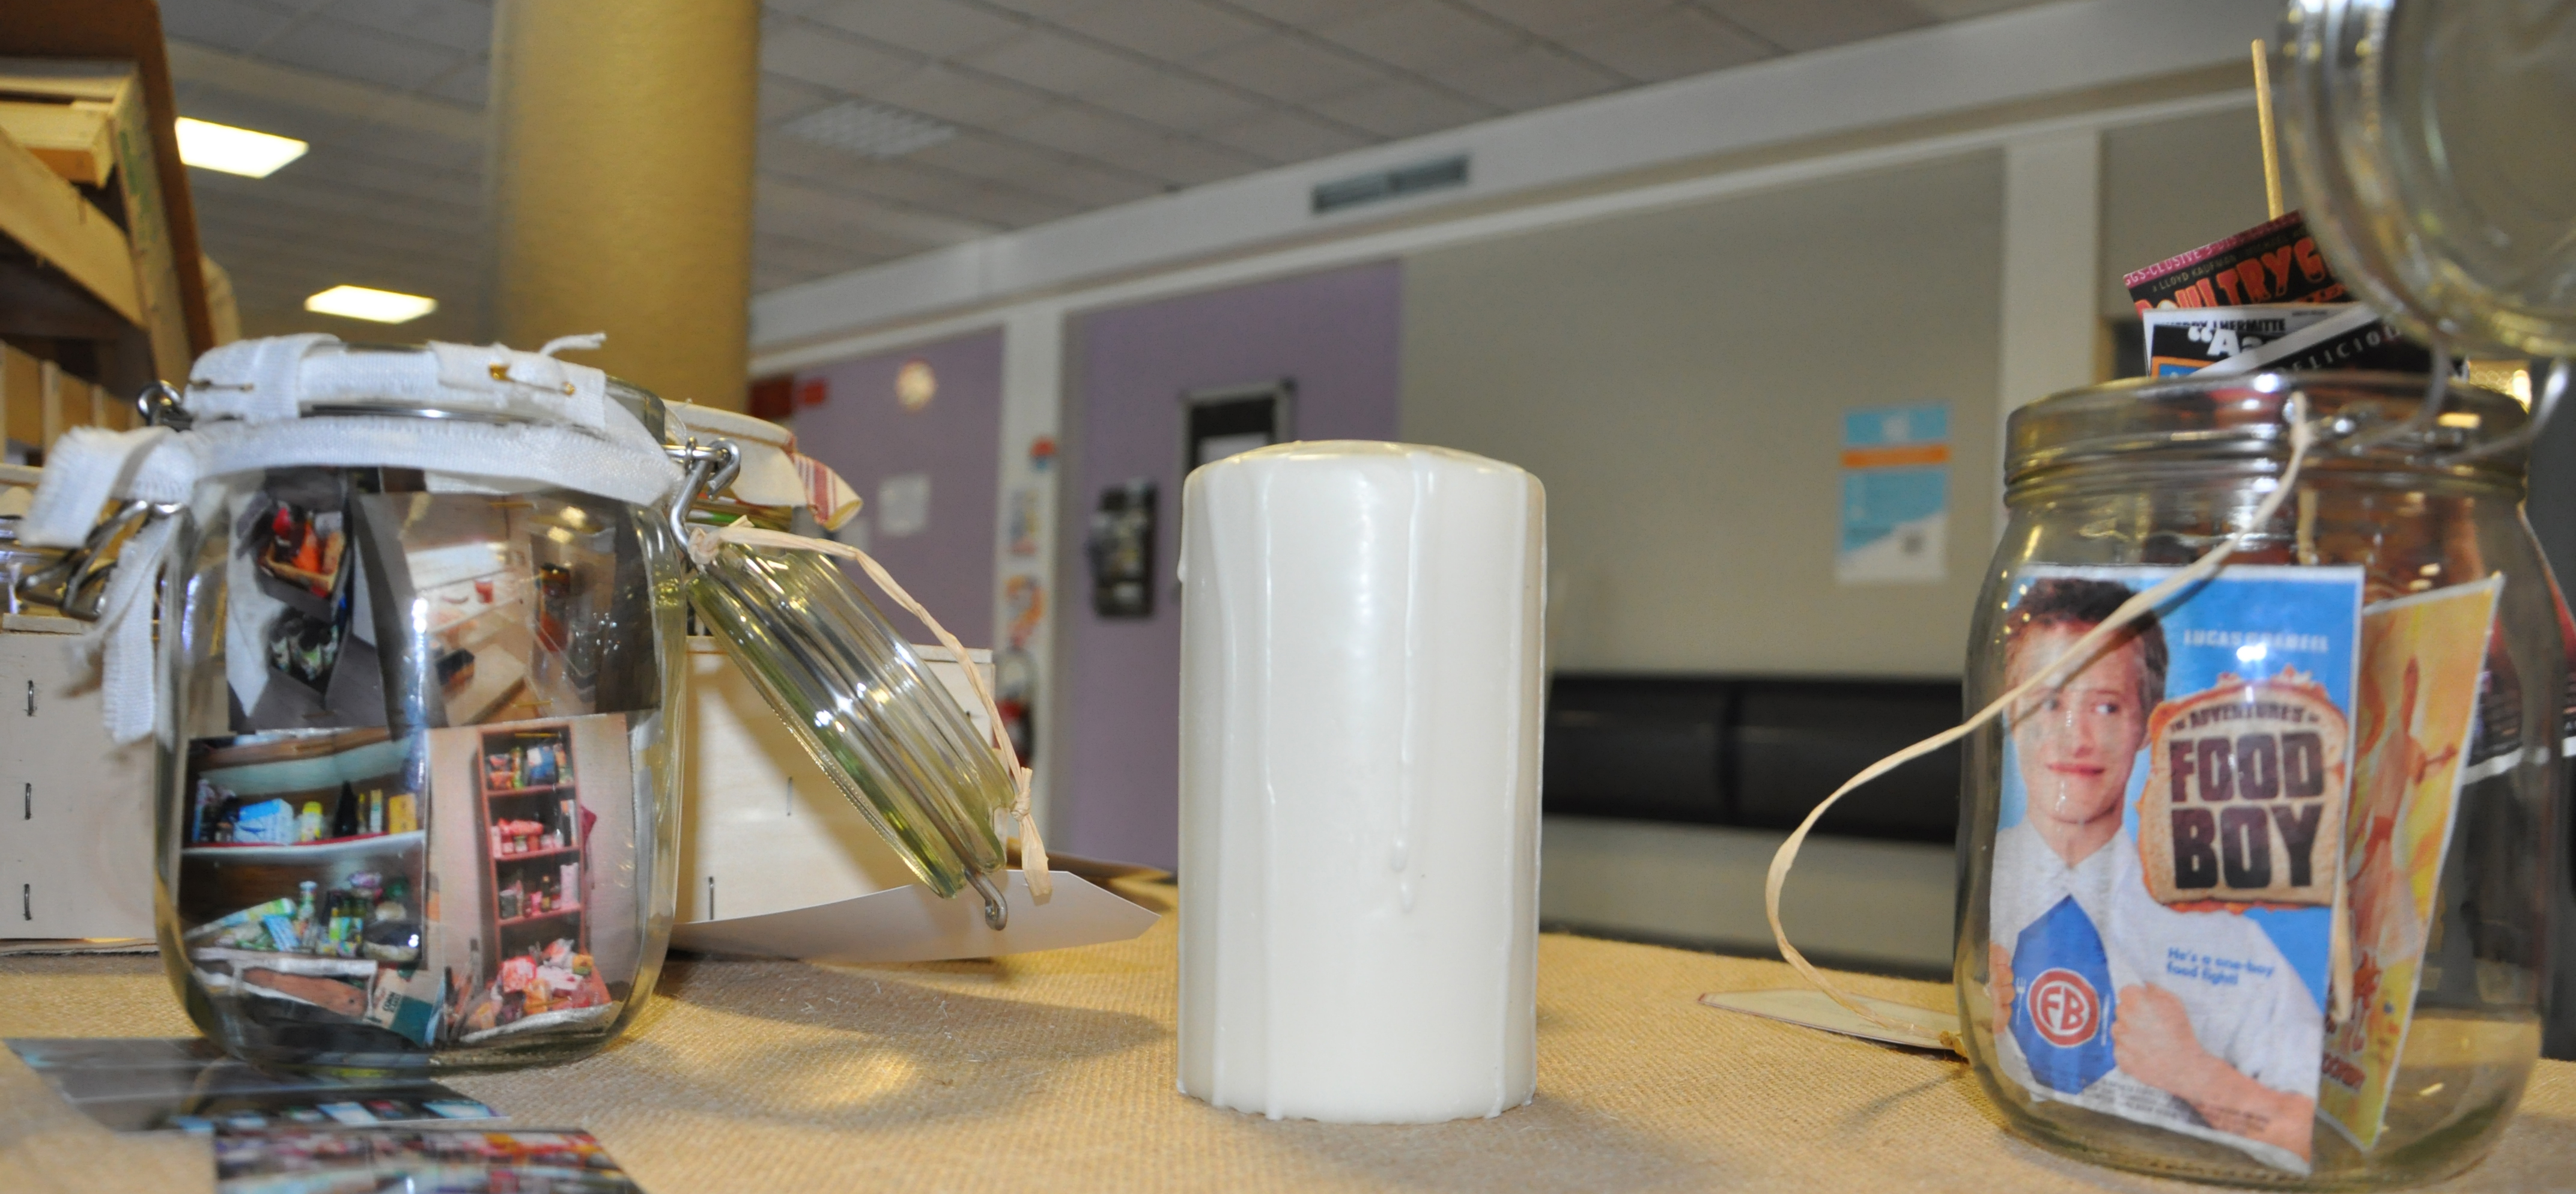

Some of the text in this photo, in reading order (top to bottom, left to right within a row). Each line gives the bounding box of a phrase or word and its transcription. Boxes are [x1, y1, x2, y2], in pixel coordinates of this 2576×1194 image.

[2158, 271, 2190, 290] LLOYD
[2169, 730, 2325, 803] FOOD
[2171, 802, 2324, 889] BOY
[2167, 962, 2198, 978] food
[2040, 985, 2085, 1031] FB
